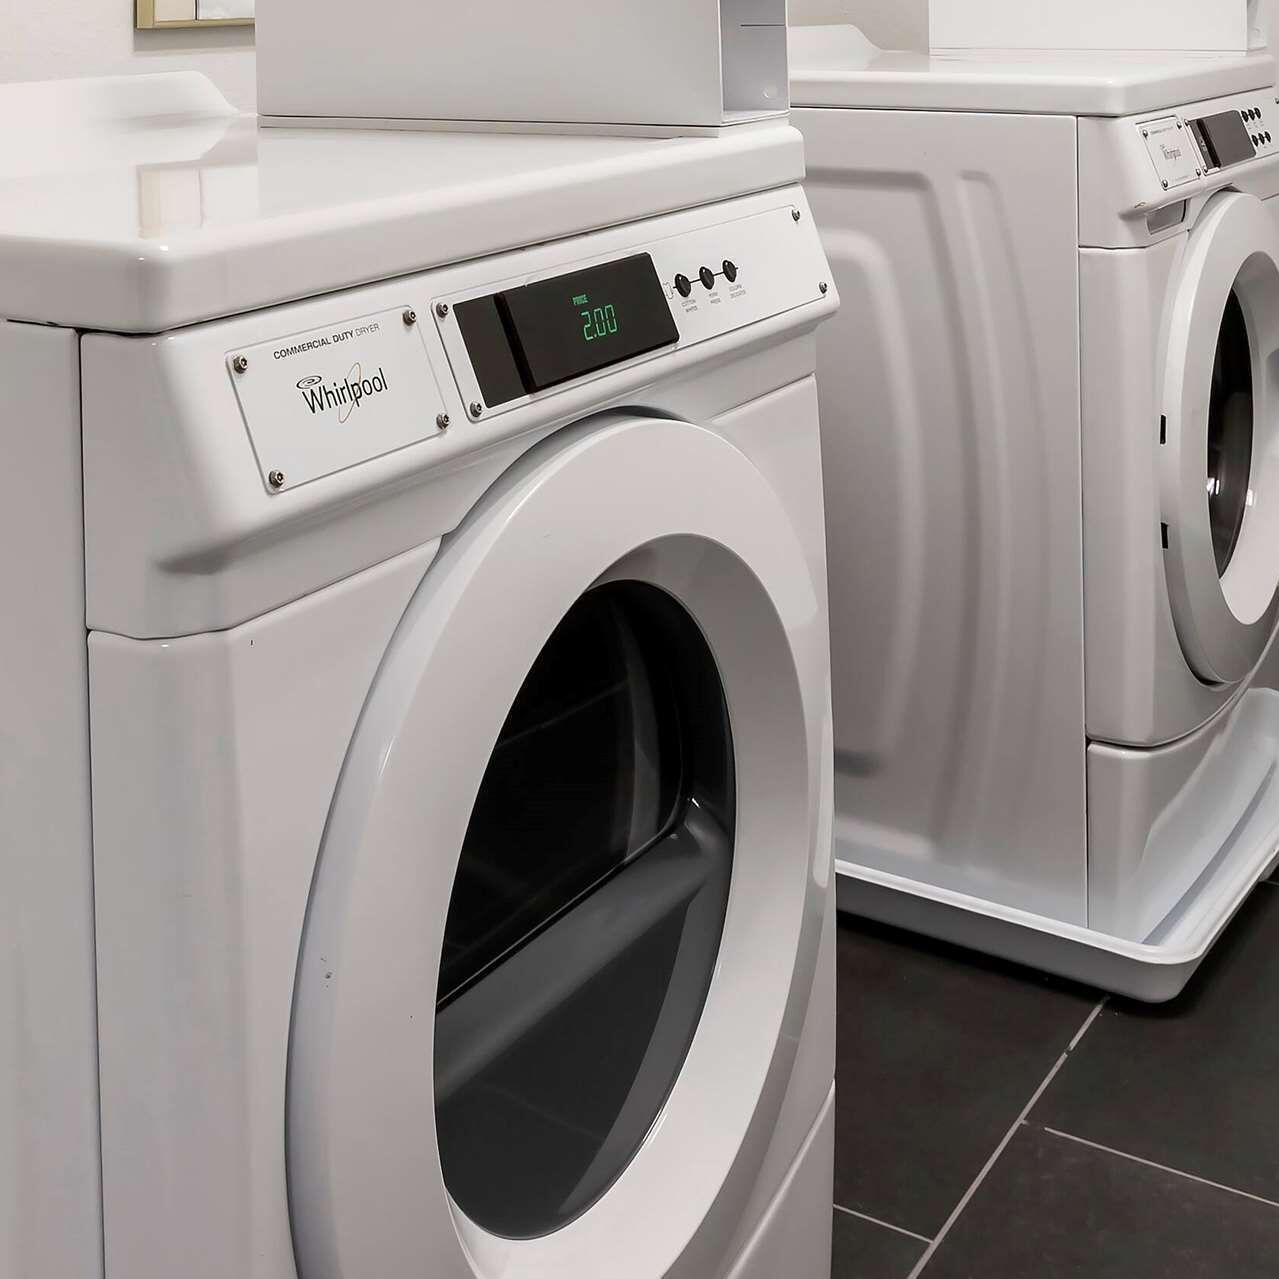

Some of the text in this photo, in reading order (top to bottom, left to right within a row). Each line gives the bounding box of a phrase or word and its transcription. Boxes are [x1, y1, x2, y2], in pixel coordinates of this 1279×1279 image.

[581, 304, 618, 341] 2.00
[273, 323, 380, 360] COMMERCIAL DUTY DRYER
[302, 367, 388, 414] Whirlpool
